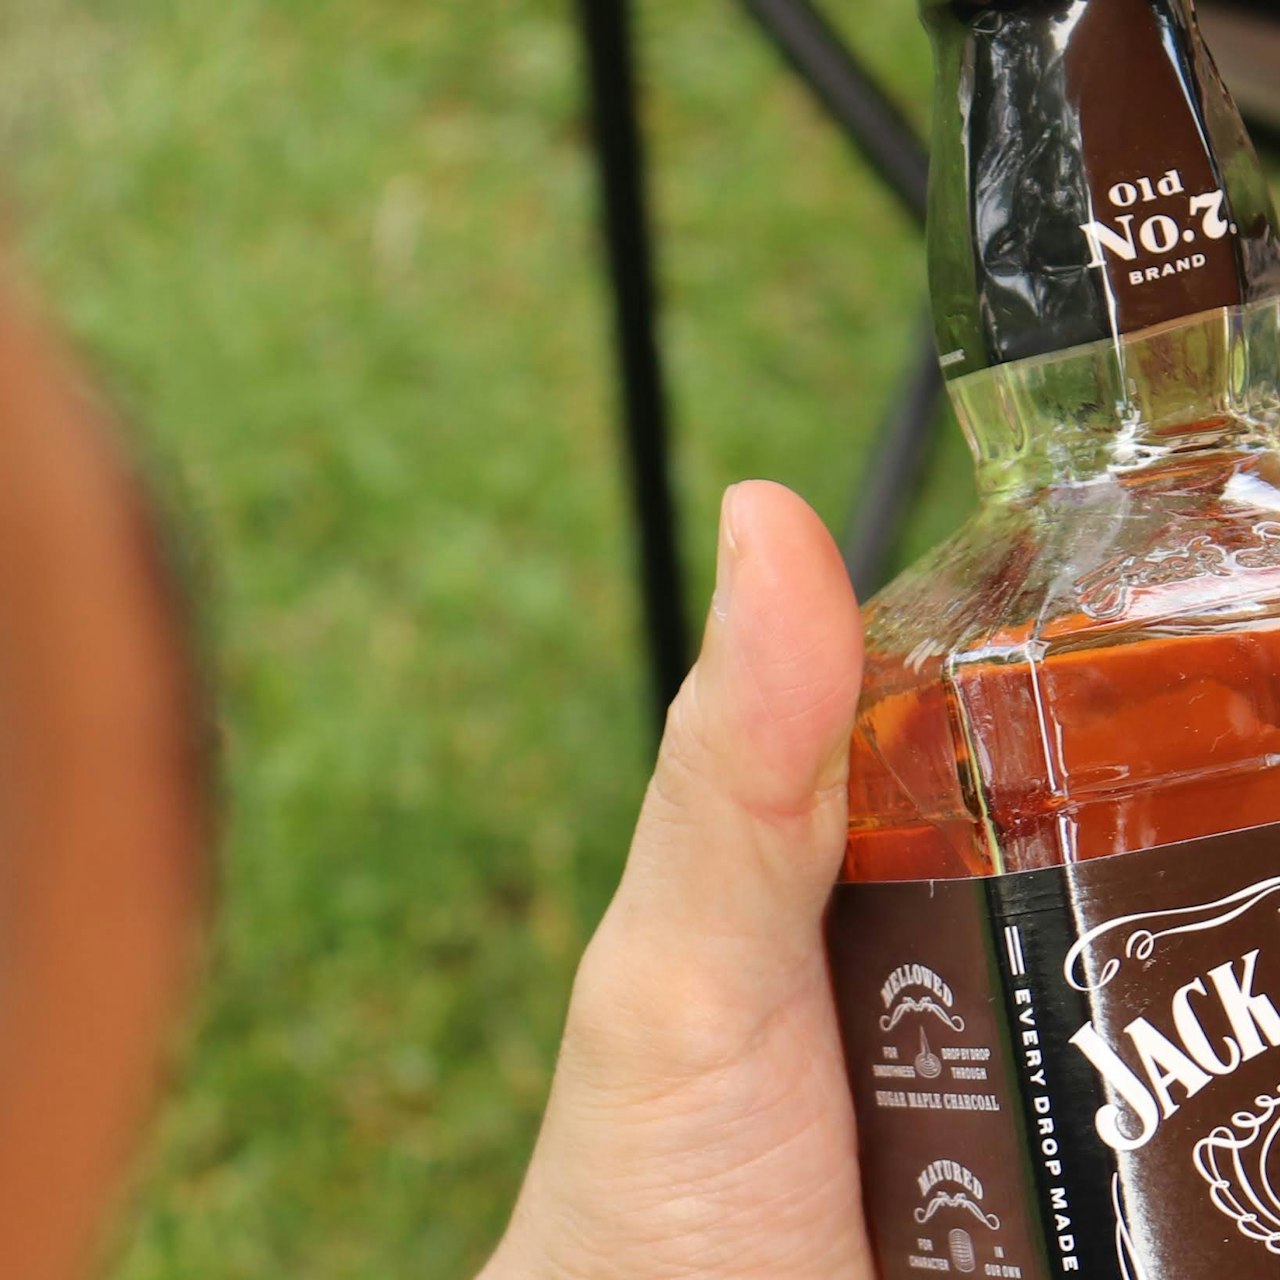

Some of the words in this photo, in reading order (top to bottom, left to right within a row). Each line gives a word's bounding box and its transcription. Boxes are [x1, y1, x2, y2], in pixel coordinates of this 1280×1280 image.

[1108, 169, 1184, 208] Old
[1128, 253, 1206, 286] BRAND
[880, 963, 953, 1009] MELLOWED
[950, 1066, 988, 1080] THROUGH
[875, 1090, 908, 1108] SUGAR
[907, 1092, 943, 1109] MAPLE
[943, 1093, 1000, 1111] CHARCOAL
[1014, 988, 1047, 1087] EVERY
[1033, 1095, 1061, 1177] DROP
[1049, 1186, 1079, 1273] MADE
[917, 1159, 984, 1201] MATURED
[917, 1238, 933, 1251] FOR
[984, 1263, 1001, 1277] OUR
